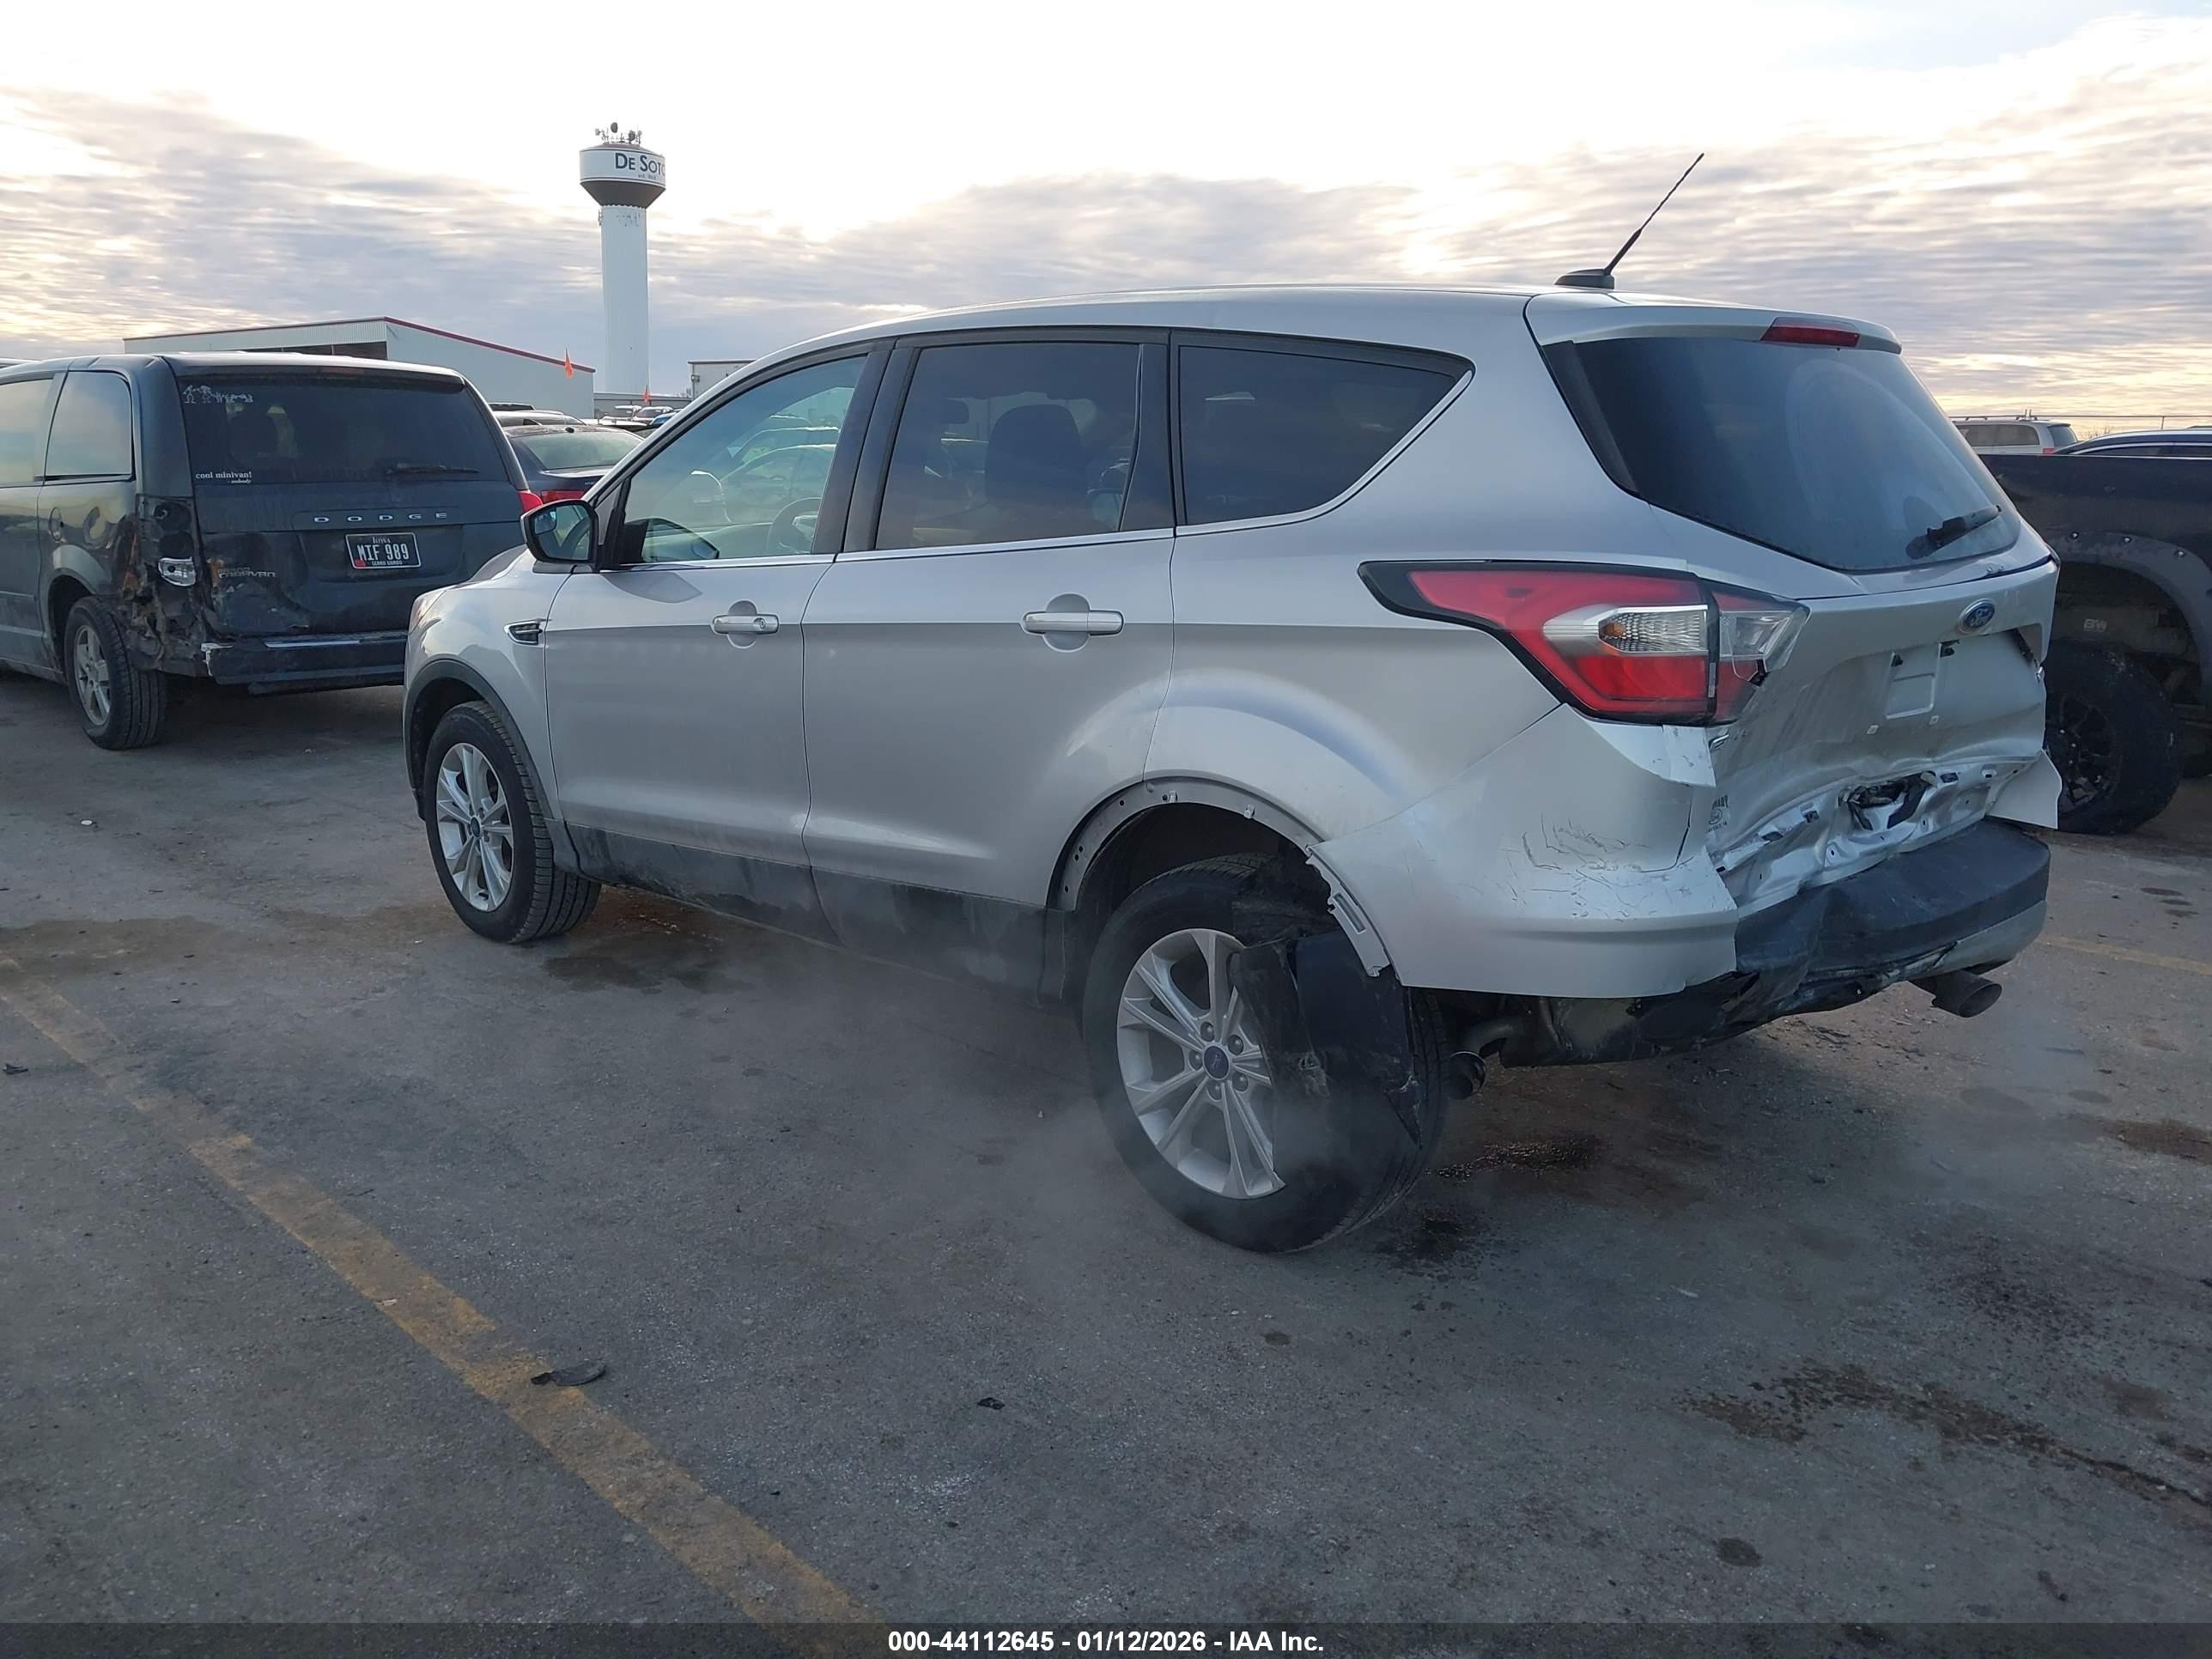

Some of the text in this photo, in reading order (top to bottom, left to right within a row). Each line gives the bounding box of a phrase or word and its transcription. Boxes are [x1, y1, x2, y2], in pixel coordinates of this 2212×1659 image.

[215, 471, 252, 479] minivan!
[313, 512, 447, 523] DODGE
[356, 544, 410, 562] MIF 989
